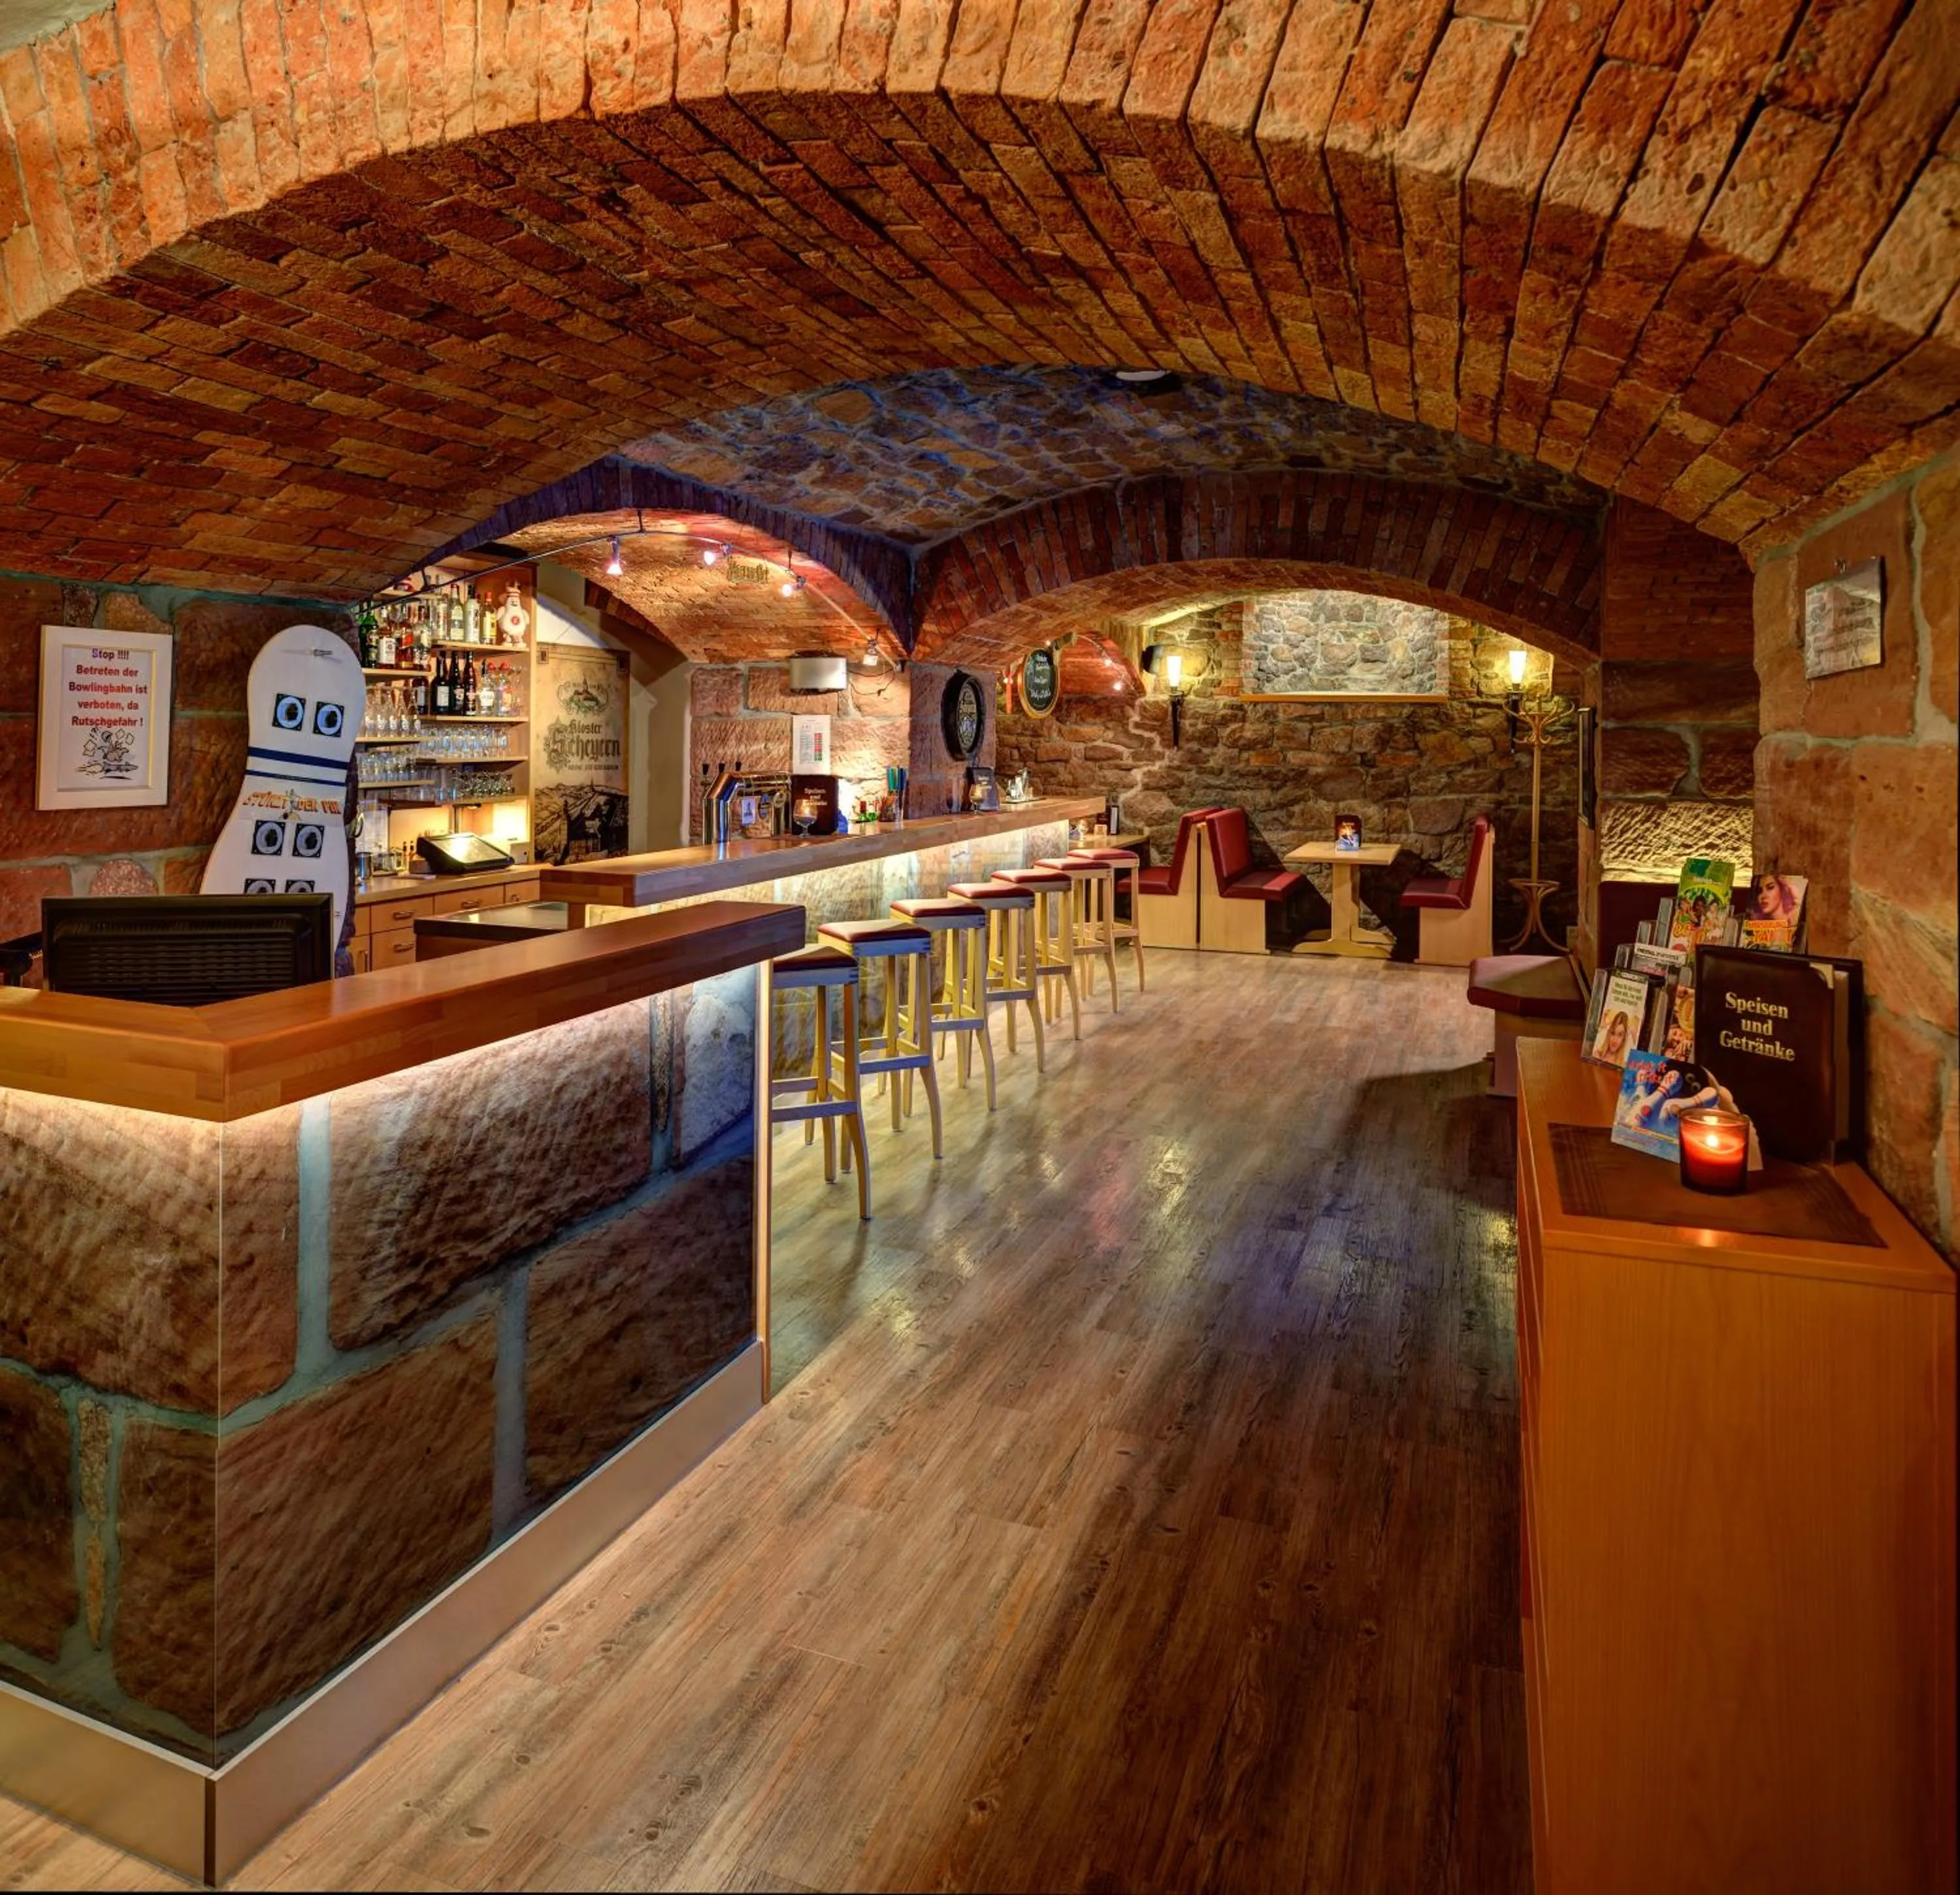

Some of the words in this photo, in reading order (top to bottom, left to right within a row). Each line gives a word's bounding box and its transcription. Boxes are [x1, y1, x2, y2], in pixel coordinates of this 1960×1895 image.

[92, 648, 114, 661] Stop
[76, 665, 120, 676] Betreten
[122, 667, 139, 676] der
[69, 682, 133, 695] Bowlingbahn
[135, 684, 147, 694] ist
[77, 700, 124, 711] verboten,
[127, 700, 139, 710] da
[72, 716, 138, 728] Rutschgefahr
[569, 719, 602, 734] Kloster
[1725, 991, 1788, 1018] Speisen
[1741, 1019, 1773, 1036] und
[1720, 1030, 1796, 1062] Getränke
